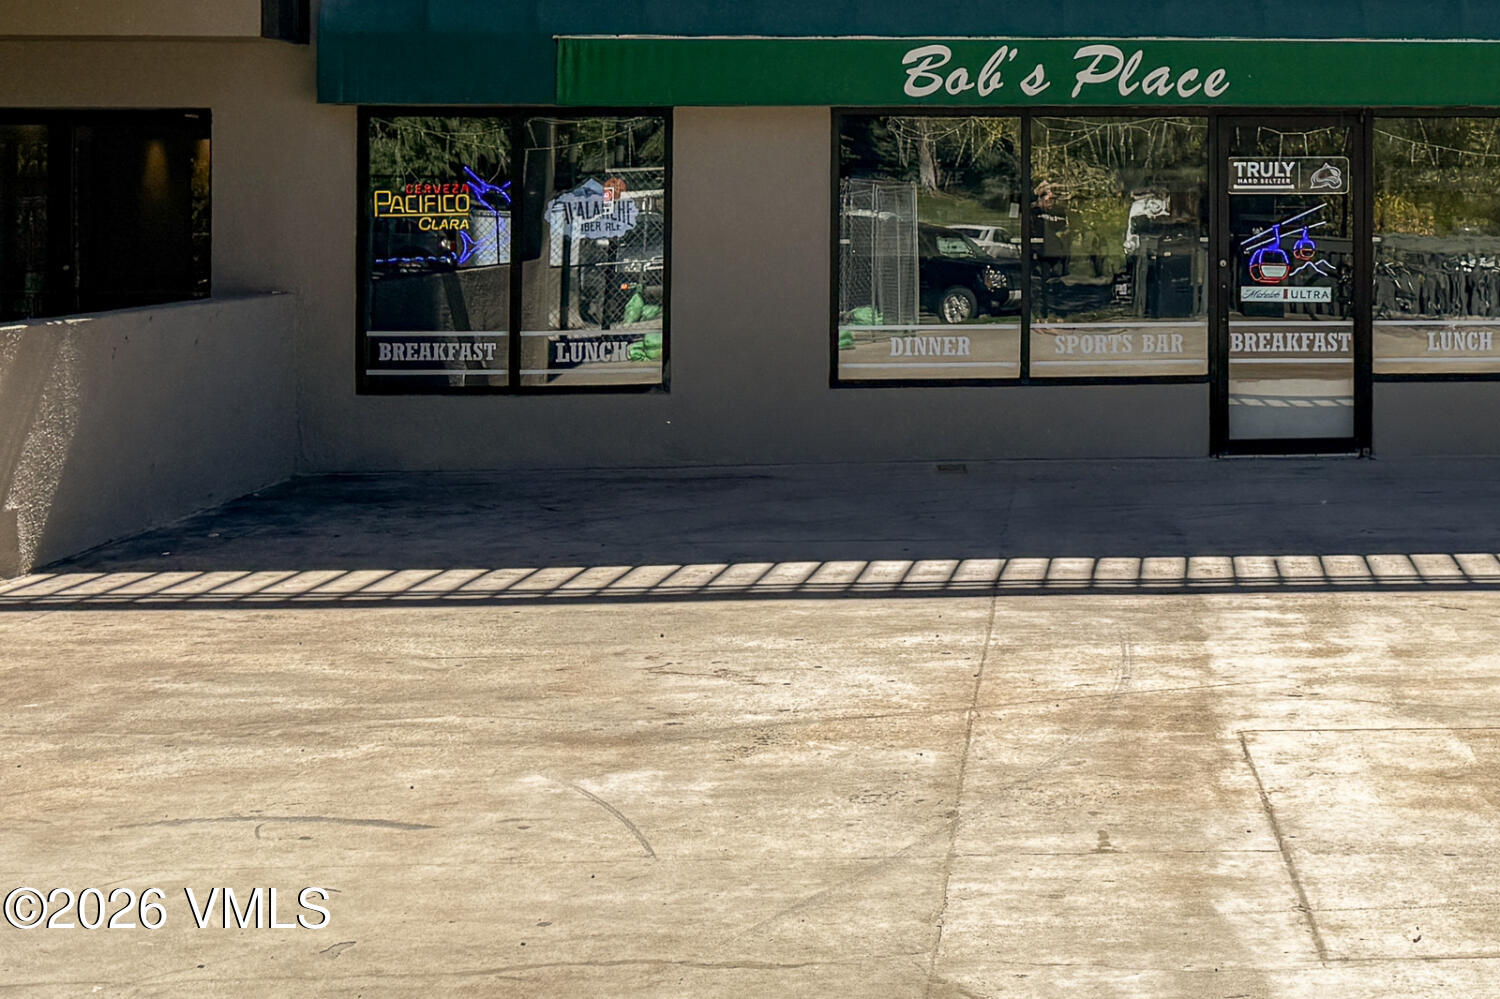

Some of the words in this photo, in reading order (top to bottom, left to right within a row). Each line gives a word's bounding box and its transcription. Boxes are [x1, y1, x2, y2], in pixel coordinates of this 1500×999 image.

[901, 44, 1051, 97] Bob's
[1071, 44, 1230, 99] Place
[1233, 161, 1295, 177] TRULY
[405, 183, 469, 194] CERVEZA
[374, 190, 470, 217] PACIFICO
[418, 217, 470, 231] CLARA
[1290, 290, 1329, 299] ULTRA
[890, 337, 971, 356] DINNER
[1055, 335, 1132, 354] SPORTS
[1142, 334, 1183, 353] BAR
[1230, 332, 1352, 352] BREAKFAST
[1427, 332, 1493, 351] LUNCH
[378, 343, 496, 361] BREAKFAST
[555, 342, 634, 362] LUNCH
